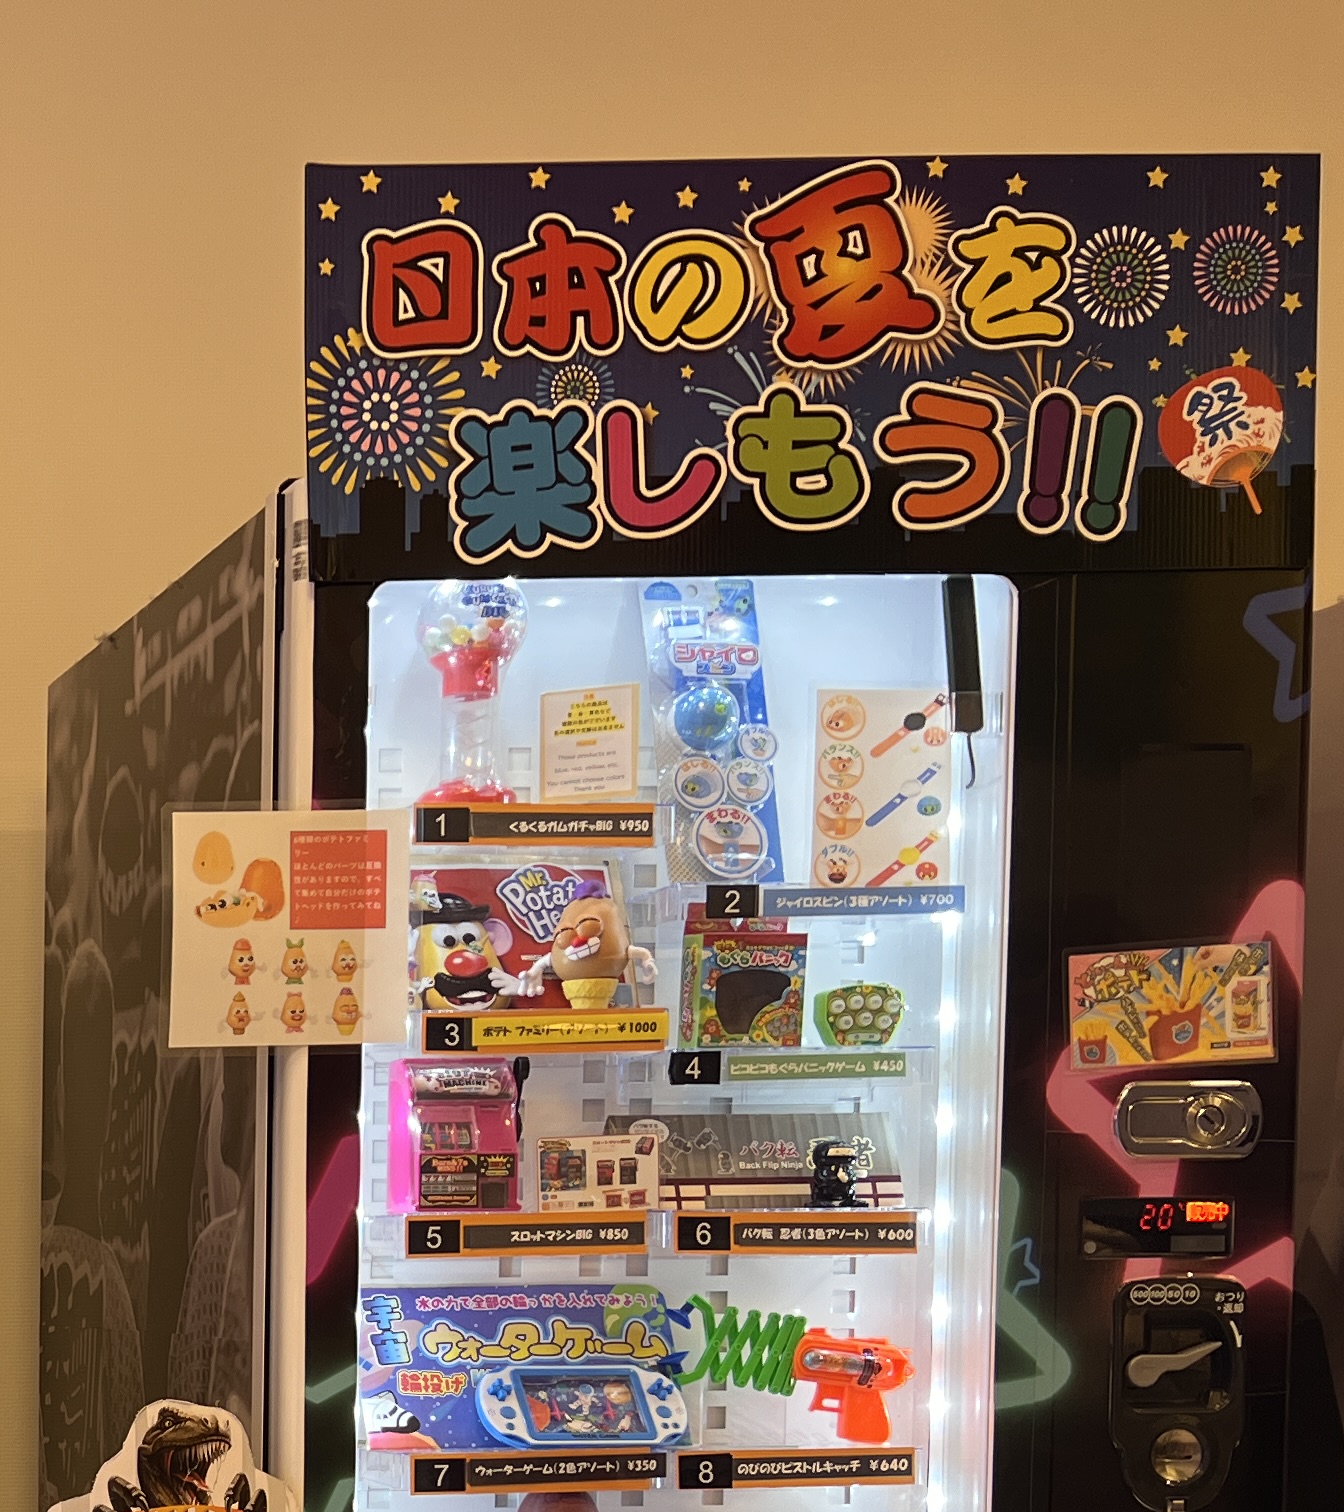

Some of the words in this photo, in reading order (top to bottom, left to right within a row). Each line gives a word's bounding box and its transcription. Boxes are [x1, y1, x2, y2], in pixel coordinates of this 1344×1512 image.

[362, 160, 1074, 368] 日本の夏を
[1182, 377, 1250, 445] 祭
[435, 813, 446, 836] 1
[509, 821, 613, 833] くるくるガムガチャBIG
[620, 820, 649, 831] ¥950
[505, 878, 576, 914] Potat
[724, 890, 741, 913] 2
[920, 894, 954, 905] ¥700
[445, 1023, 460, 1046] 3
[482, 1026, 512, 1037] ポテト
[617, 1022, 658, 1033] ¥1000
[685, 1056, 701, 1079] 4
[873, 1060, 904, 1071] ¥450
[739, 1140, 800, 1159] バク転
[739, 1160, 760, 1170] Back
[762, 1160, 779, 1170] Flip
[781, 1160, 804, 1170] Ninja
[1140, 1203, 1174, 1231] 20
[426, 1226, 442, 1249] 5
[511, 1229, 593, 1243] スロットマシンBIG
[599, 1228, 629, 1240] ¥850
[695, 1222, 712, 1246] 6
[742, 1228, 773, 1240] バク転
[877, 1228, 914, 1240] ¥600
[362, 1295, 412, 1365] 宇宙
[423, 1318, 669, 1362] ウォーターゲーム
[398, 1370, 467, 1395] 輪投げ
[434, 1464, 449, 1487] 7
[475, 1461, 620, 1476] ウォーターゲーム(2色アソート)
[627, 1459, 657, 1472] ¥350
[698, 1461, 713, 1483] 8
[737, 1461, 861, 1475] のびのびピストルキャッチ
[869, 1458, 909, 1472] ¥640
